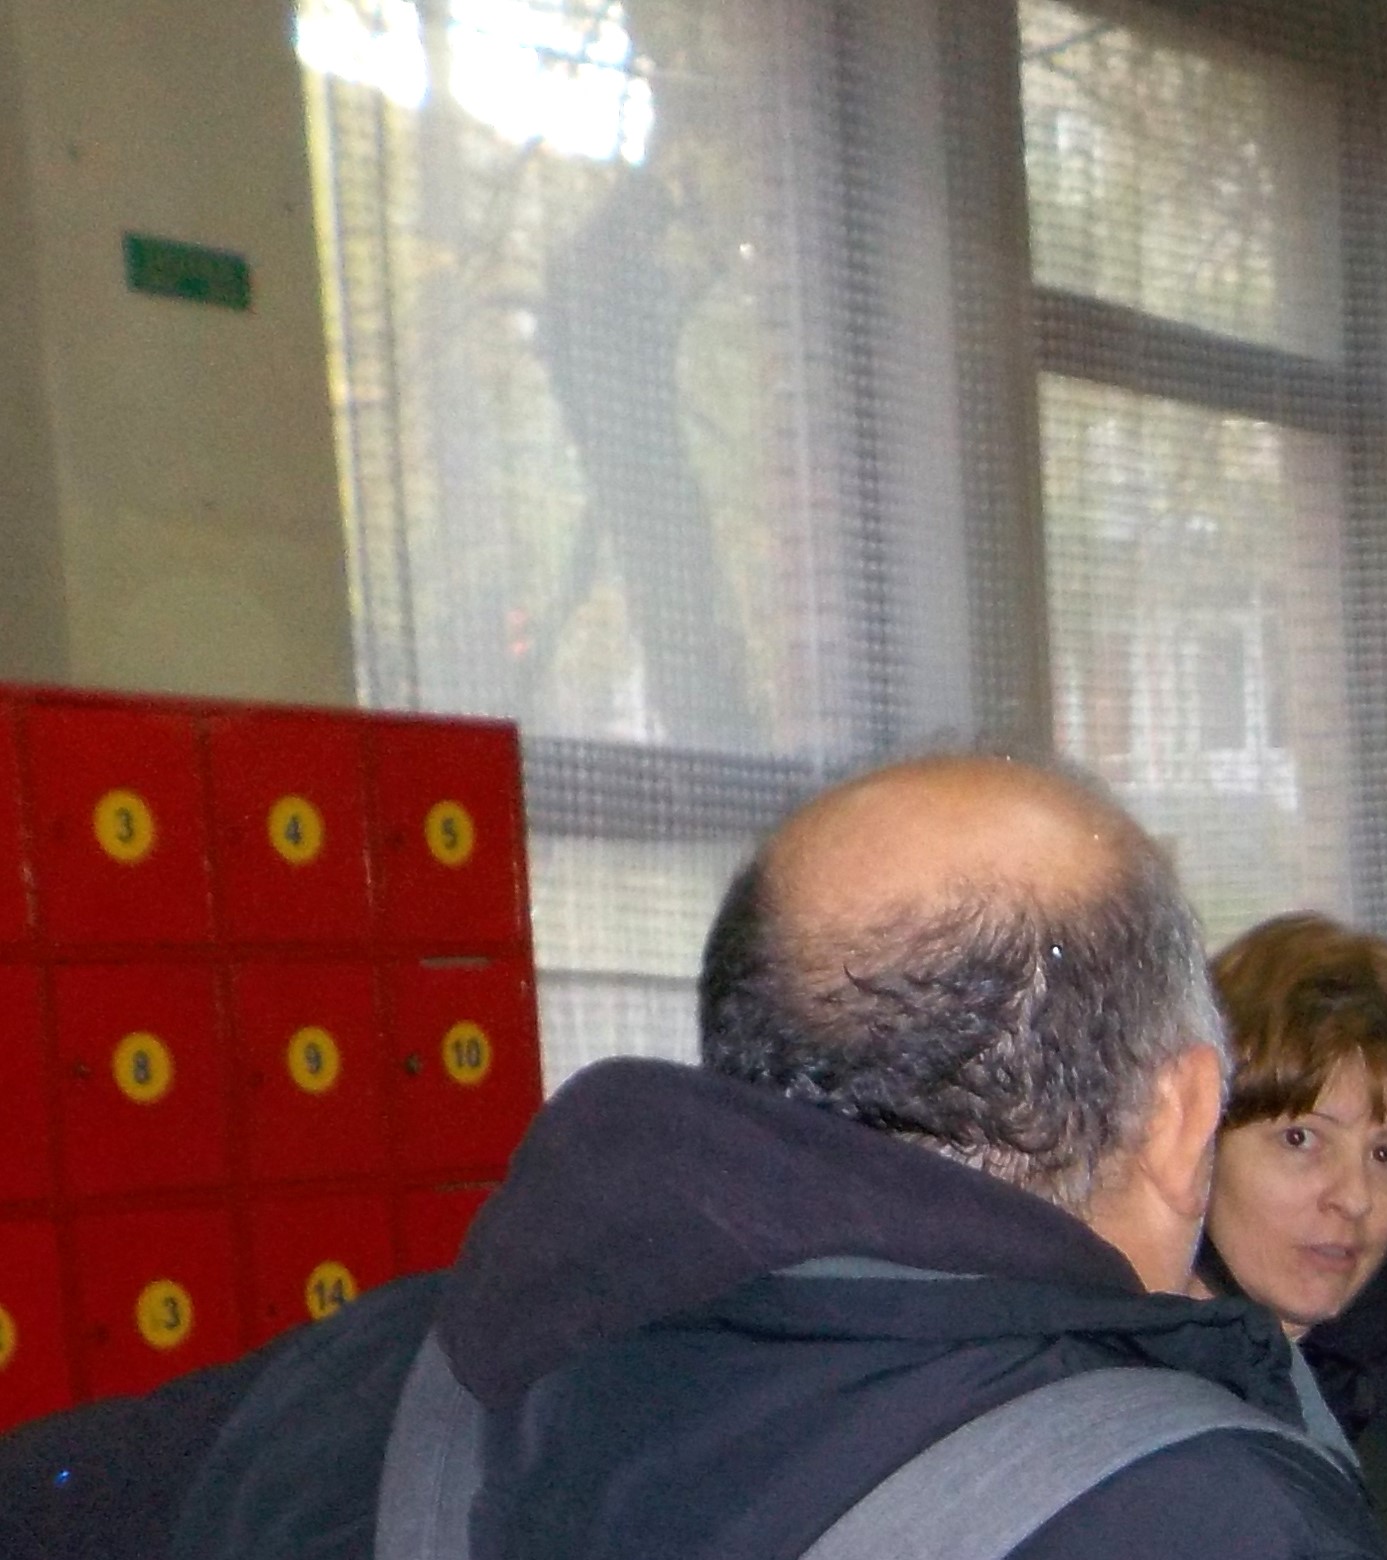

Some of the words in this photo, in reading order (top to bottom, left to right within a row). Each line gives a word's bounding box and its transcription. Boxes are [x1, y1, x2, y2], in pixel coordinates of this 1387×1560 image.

[115, 807, 134, 844] 3
[284, 815, 304, 847] 4
[440, 817, 458, 850] 5
[132, 1048, 151, 1085] 8
[304, 1041, 323, 1075] 9
[453, 1037, 482, 1068] 10
